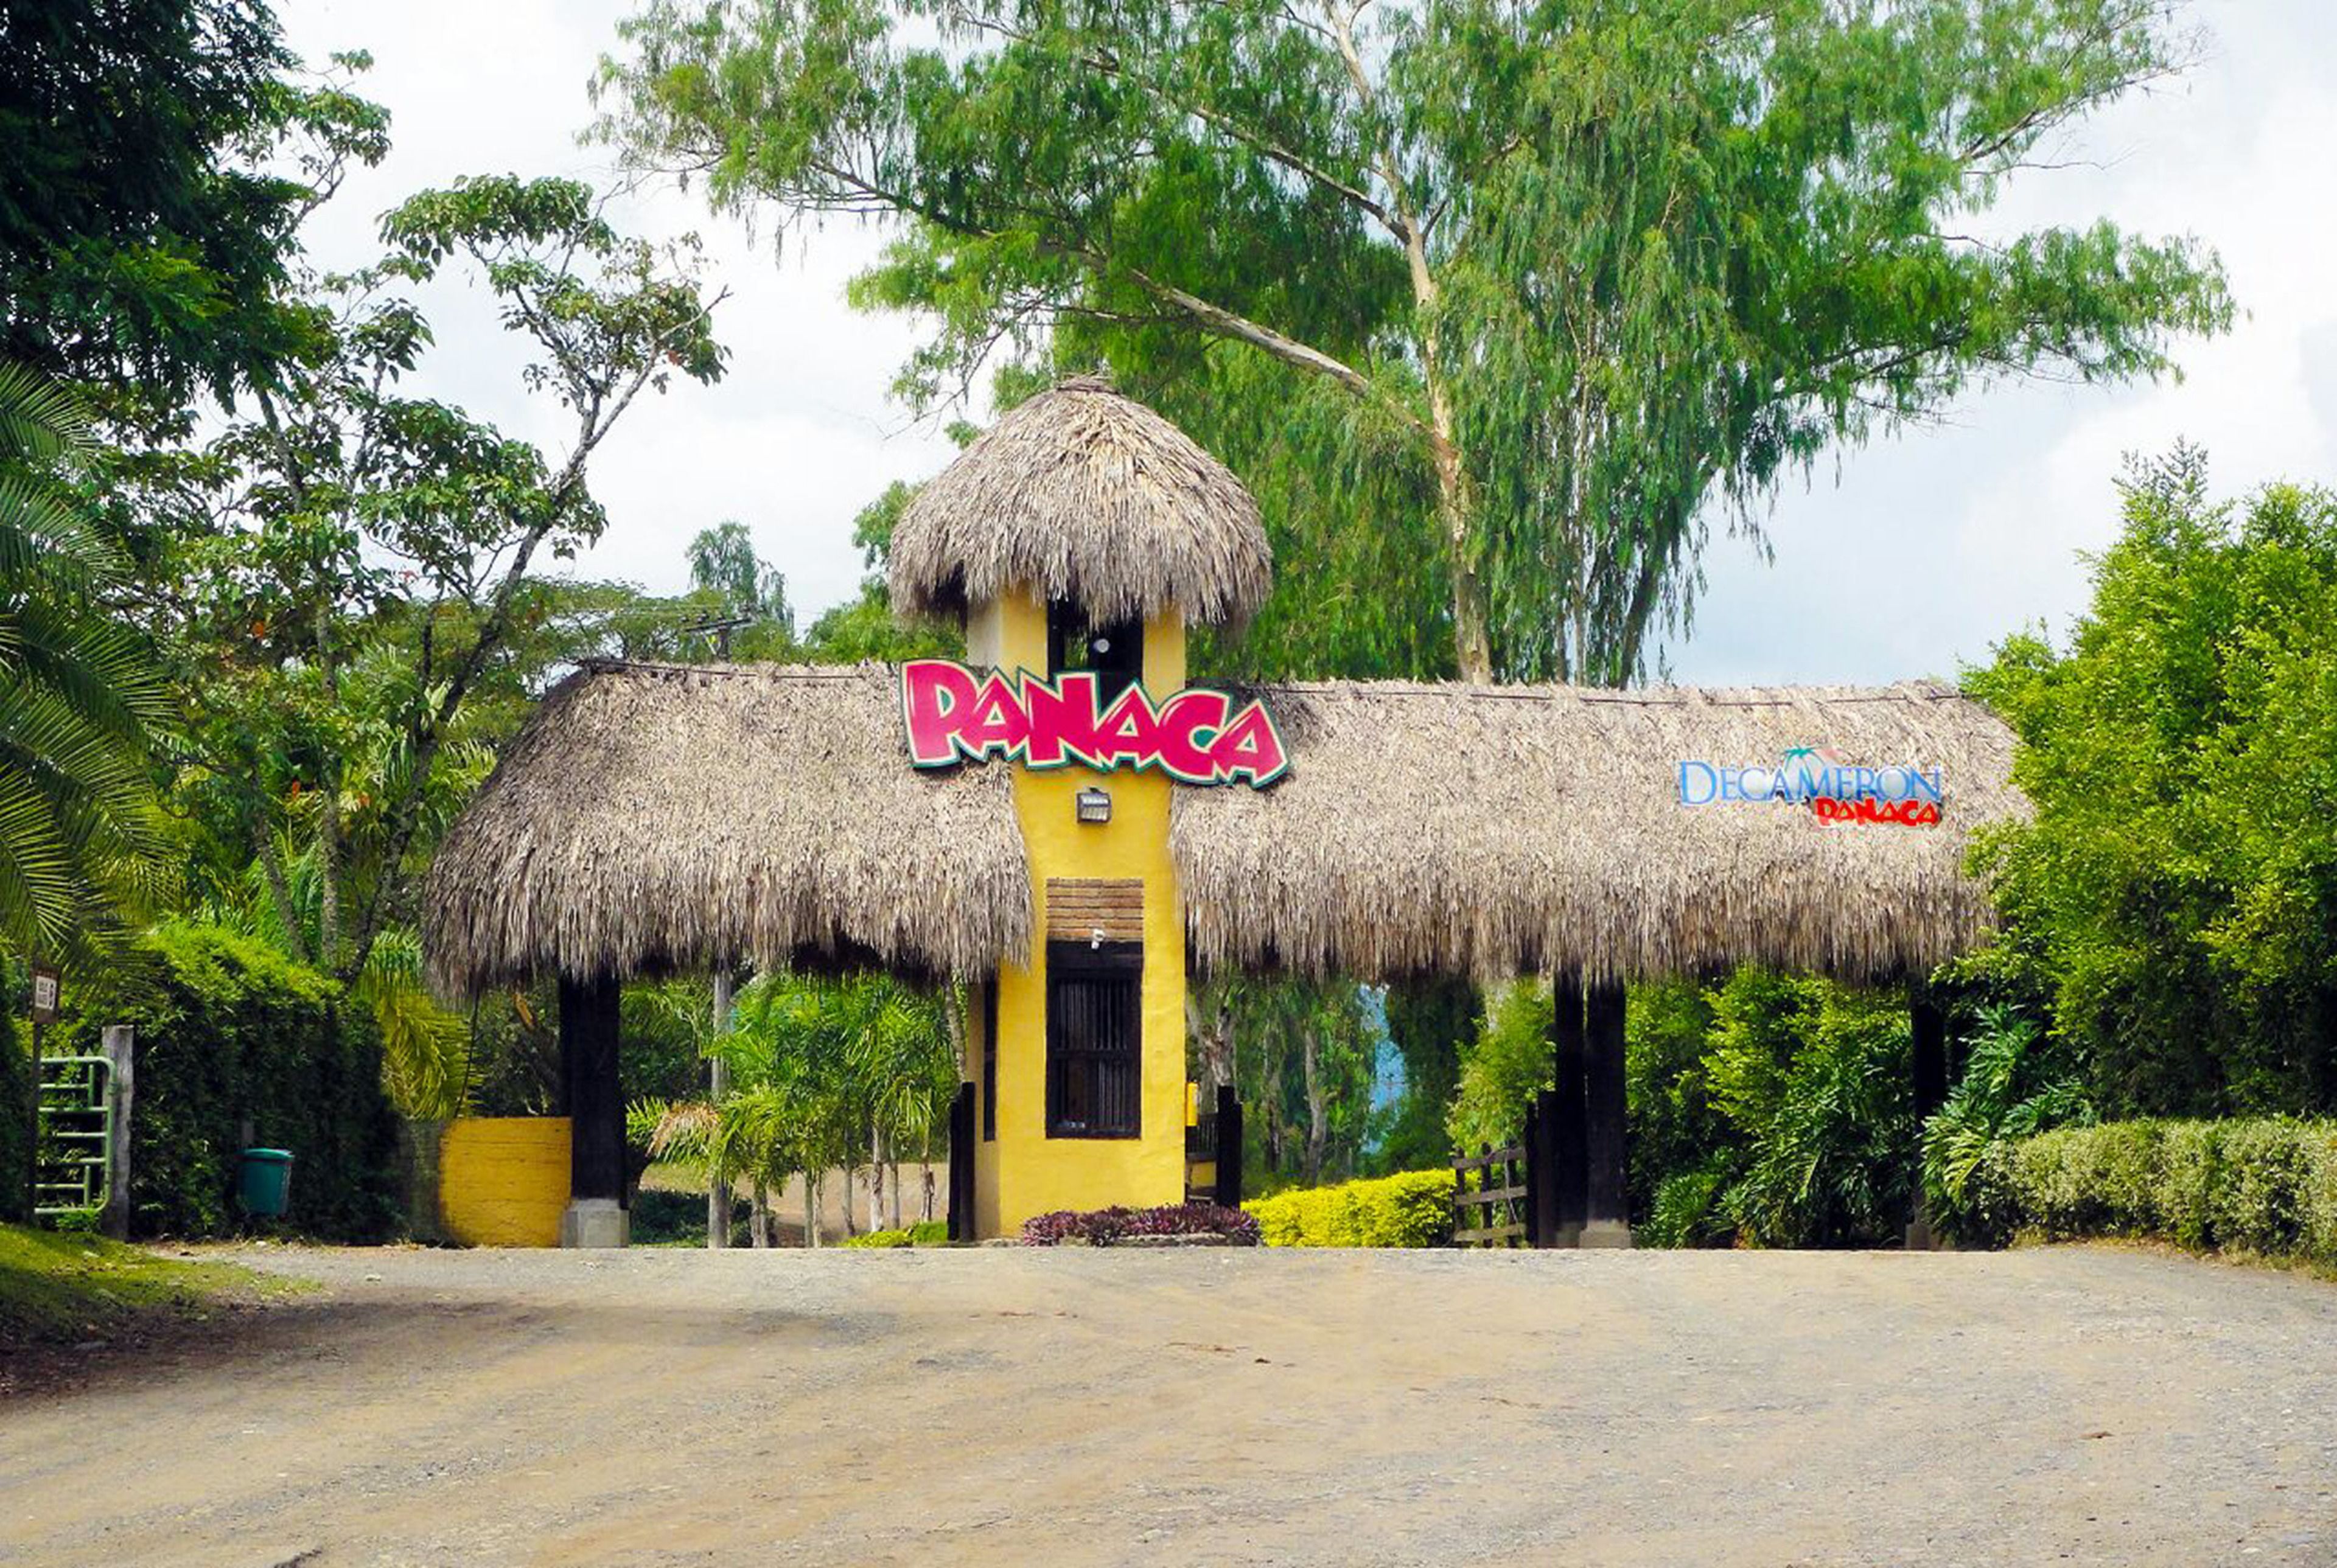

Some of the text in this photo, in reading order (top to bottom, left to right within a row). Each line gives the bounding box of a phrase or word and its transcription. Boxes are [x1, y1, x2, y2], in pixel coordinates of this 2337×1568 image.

[905, 662, 1287, 785] PANACA
[1680, 760, 1940, 804] DECAMERON
[1815, 796, 1940, 827] PANACA
